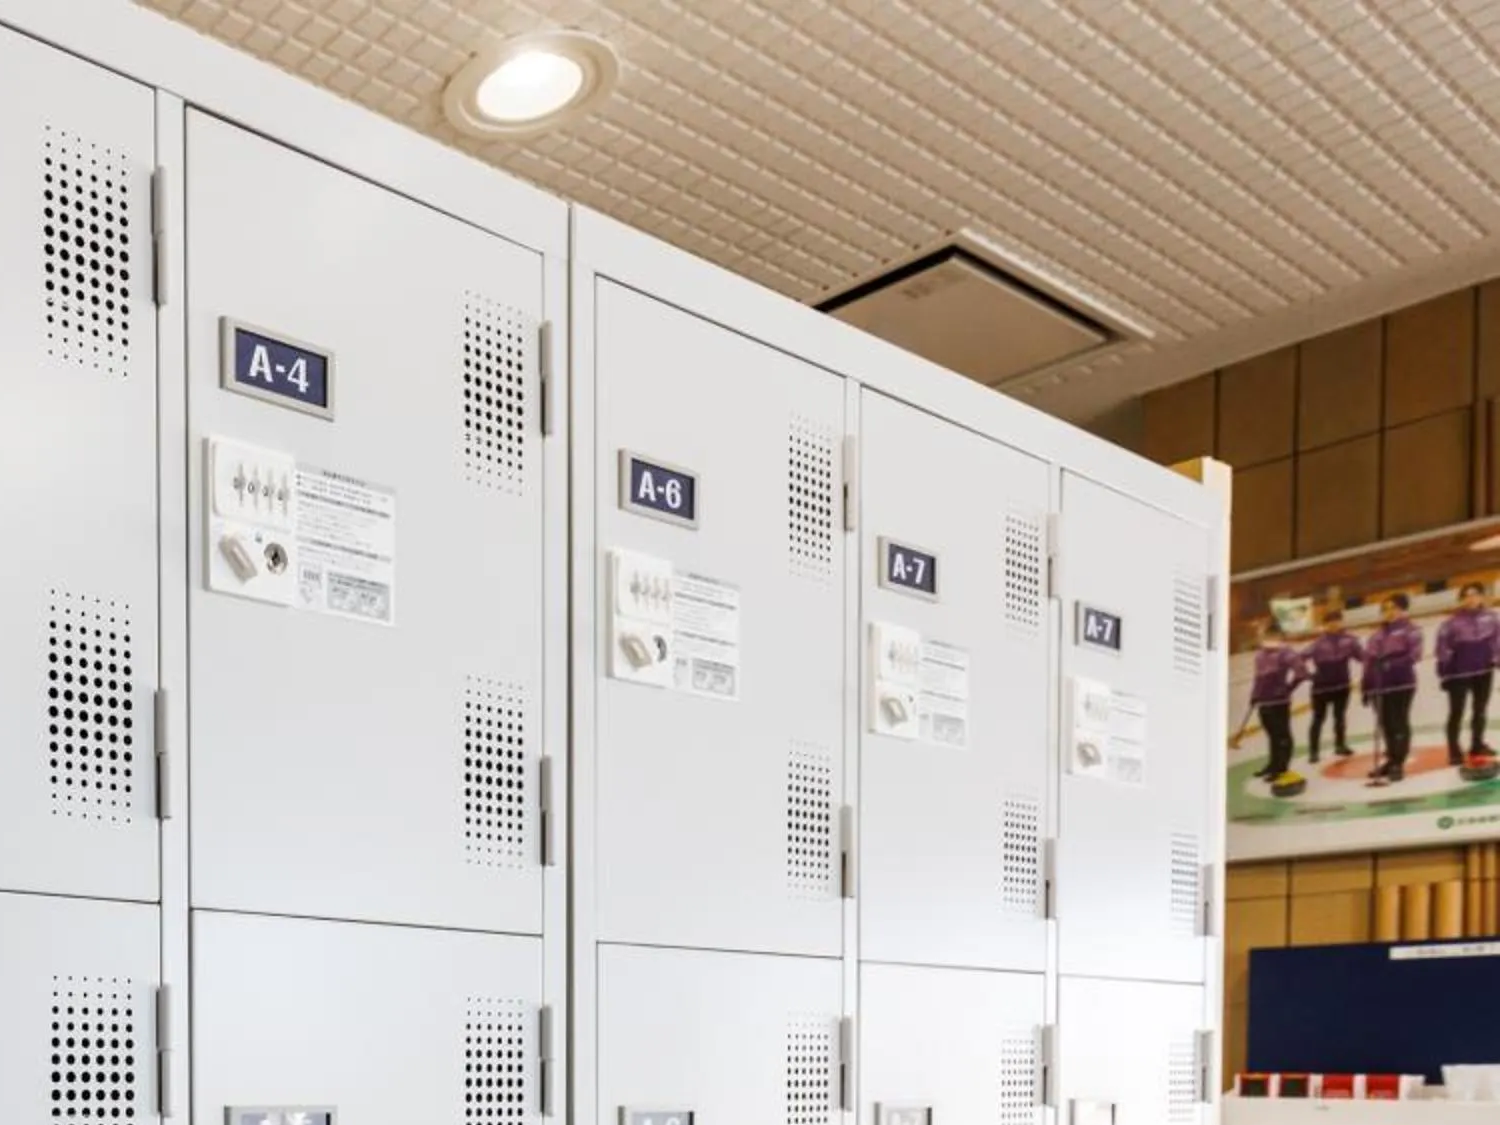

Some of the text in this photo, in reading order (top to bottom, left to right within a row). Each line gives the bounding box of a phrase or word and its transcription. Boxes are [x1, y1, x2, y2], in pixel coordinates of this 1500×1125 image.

[249, 344, 309, 393] A-4
[638, 470, 682, 509] A-6
[892, 553, 926, 584] A-7
[1086, 614, 1113, 641] A-7
